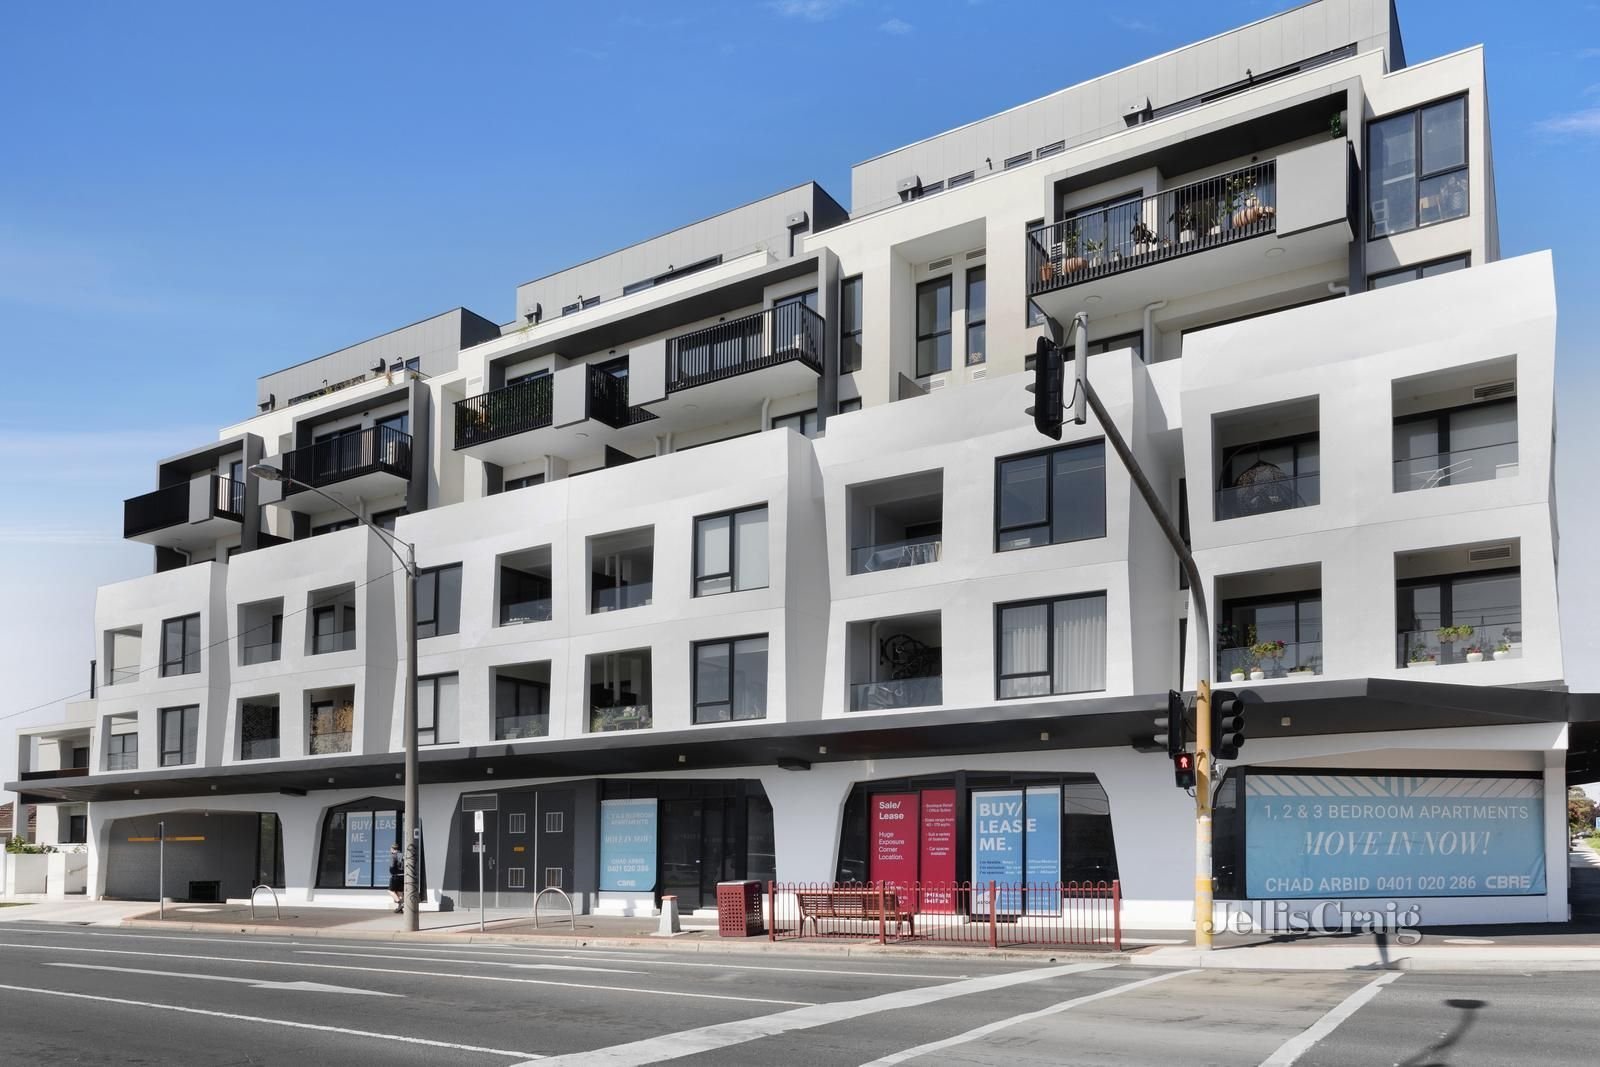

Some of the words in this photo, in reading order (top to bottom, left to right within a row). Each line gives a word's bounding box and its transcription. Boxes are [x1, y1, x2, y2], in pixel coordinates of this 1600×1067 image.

[879, 801, 901, 809] Sale/
[979, 801, 1023, 817] BUY/
[1283, 804, 1294, 819] 2
[1297, 804, 1309, 819] &
[1312, 804, 1323, 819] 3
[1328, 804, 1415, 819] BEDROOM
[1419, 804, 1529, 820] APARTMENTS
[879, 812, 905, 820] Lease
[375, 820, 397, 829] LEAS
[979, 818, 1037, 833] LEASE
[351, 832, 368, 842] ME.
[979, 837, 1013, 851] ME.
[1299, 831, 1383, 856] MOVE
[1384, 831, 1417, 856] IN
[1419, 831, 1491, 855] NOW!
[1265, 877, 1314, 892] CHAD
[1319, 877, 1370, 891] ARBID
[1376, 876, 1413, 890] 0401
[1418, 876, 1445, 890] 020
[1449, 876, 1477, 889] 286
[1485, 875, 1531, 889] CBRE
